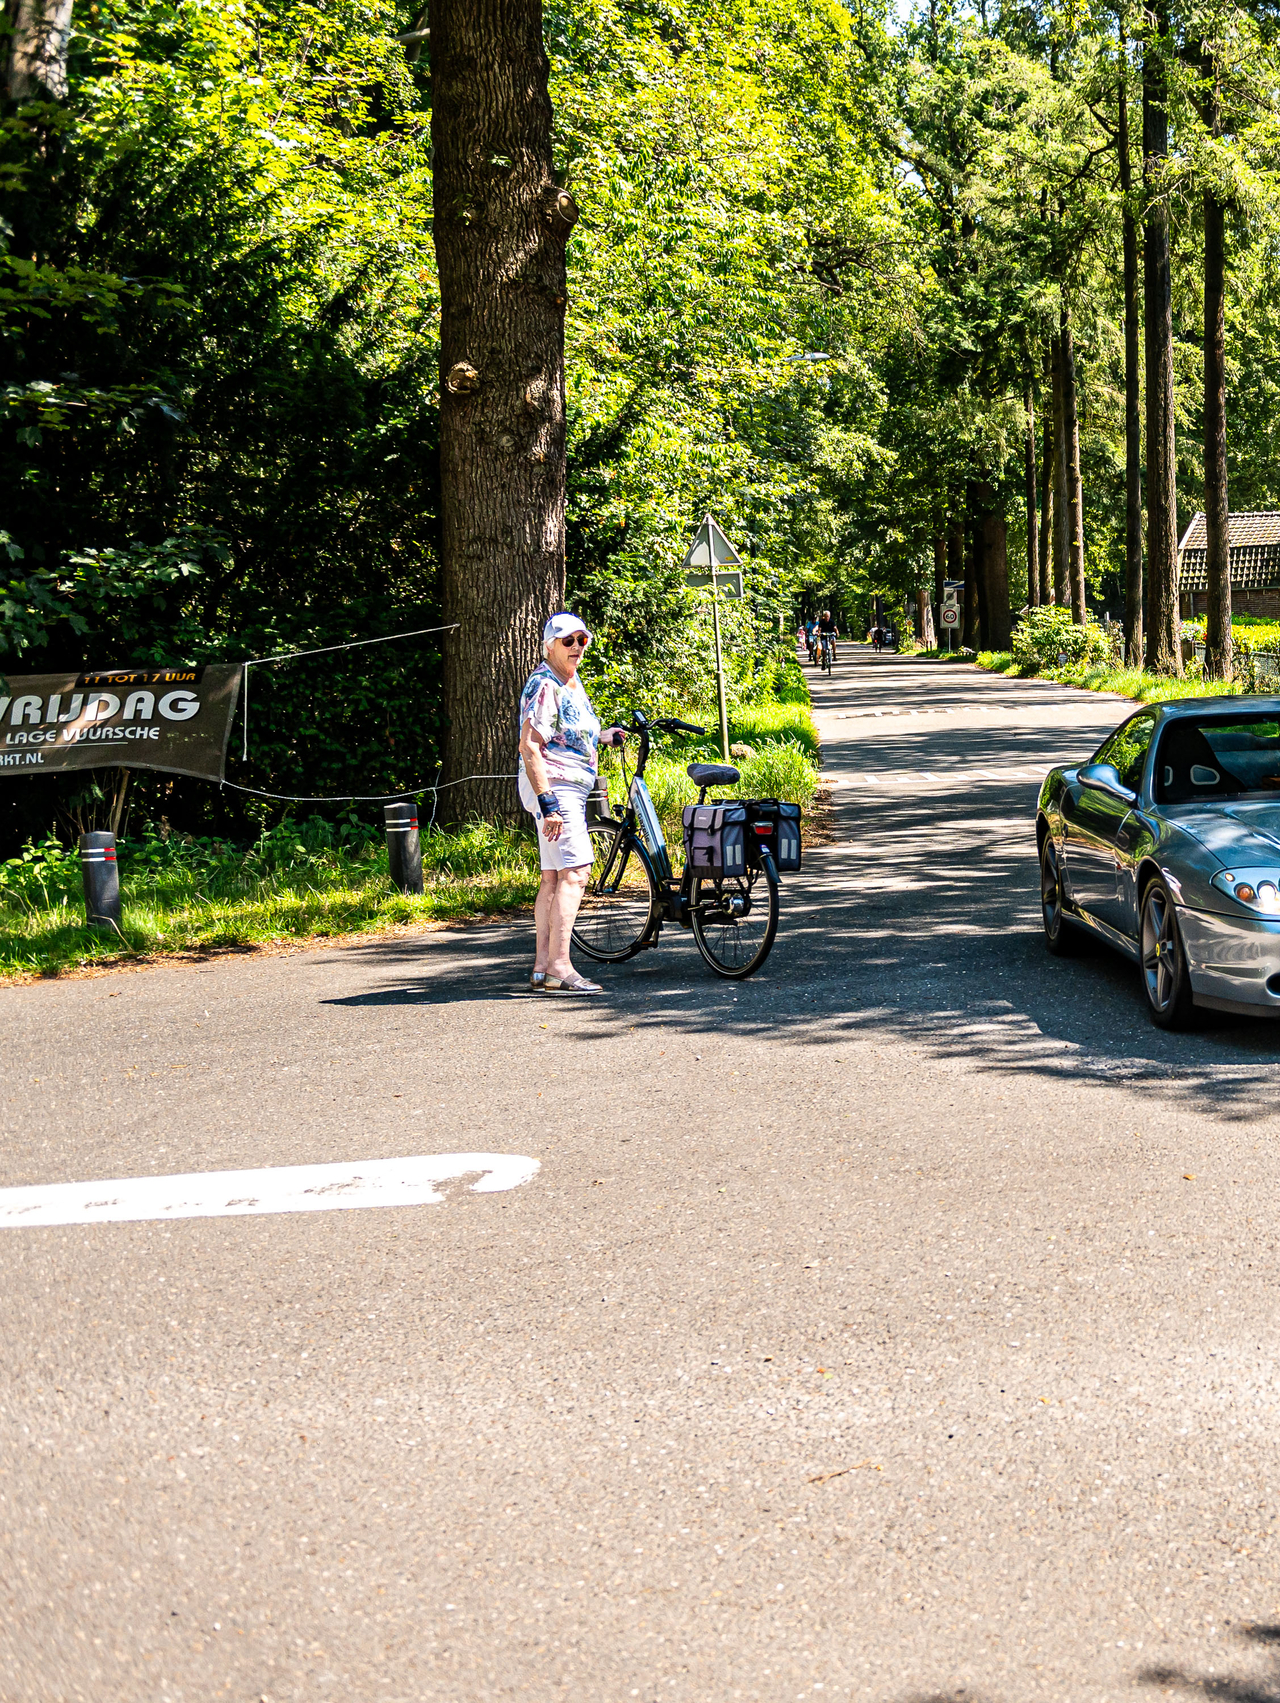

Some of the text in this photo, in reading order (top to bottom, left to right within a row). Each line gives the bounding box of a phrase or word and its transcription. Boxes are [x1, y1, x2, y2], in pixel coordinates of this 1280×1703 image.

[84, 672, 196, 684] 11 TOT 17 UUR
[5, 727, 160, 745] LAGE VUURSCHE
